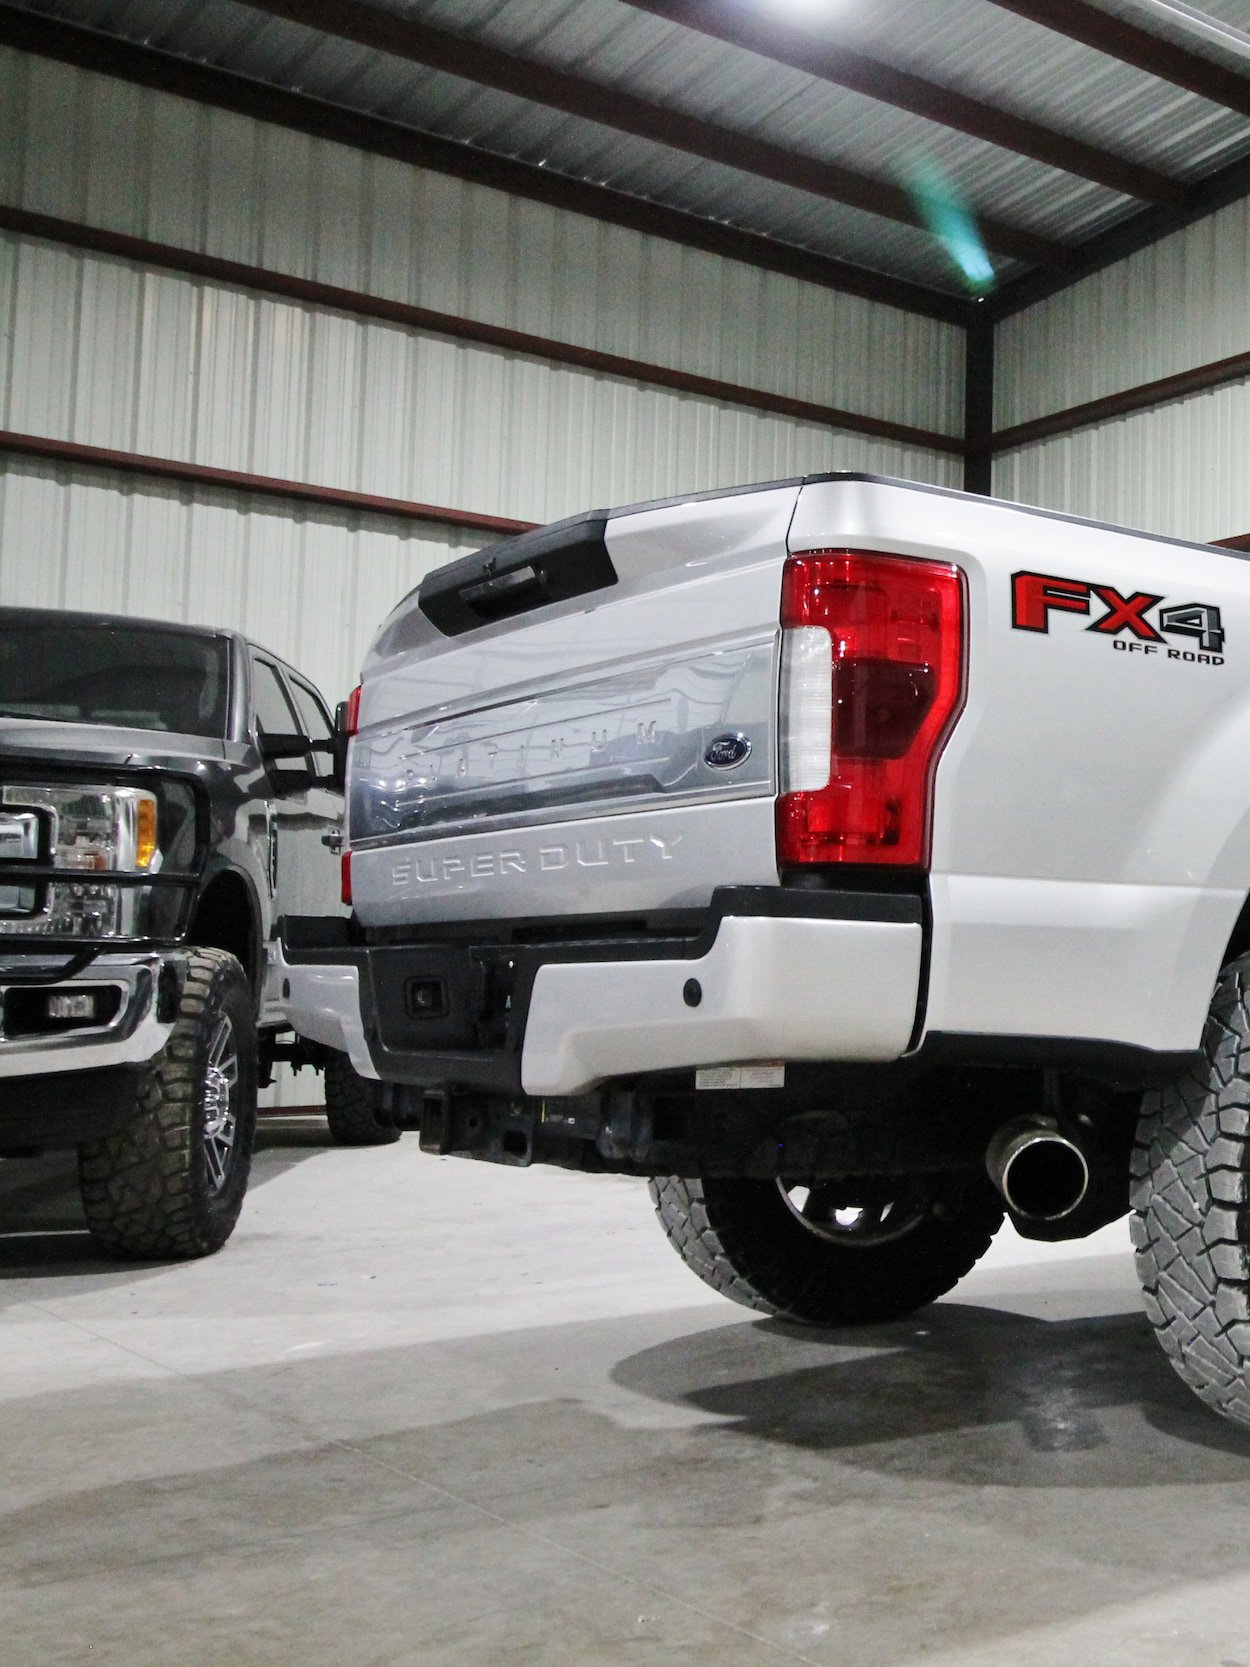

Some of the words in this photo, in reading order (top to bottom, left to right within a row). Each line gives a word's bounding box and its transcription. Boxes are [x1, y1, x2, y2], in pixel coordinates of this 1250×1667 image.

[1010, 570, 1225, 653] FX4
[1112, 639, 1158, 655] OFF
[1167, 648, 1225, 666] ROAD
[391, 852, 527, 885] SUPER
[539, 835, 683, 870] DUTY
